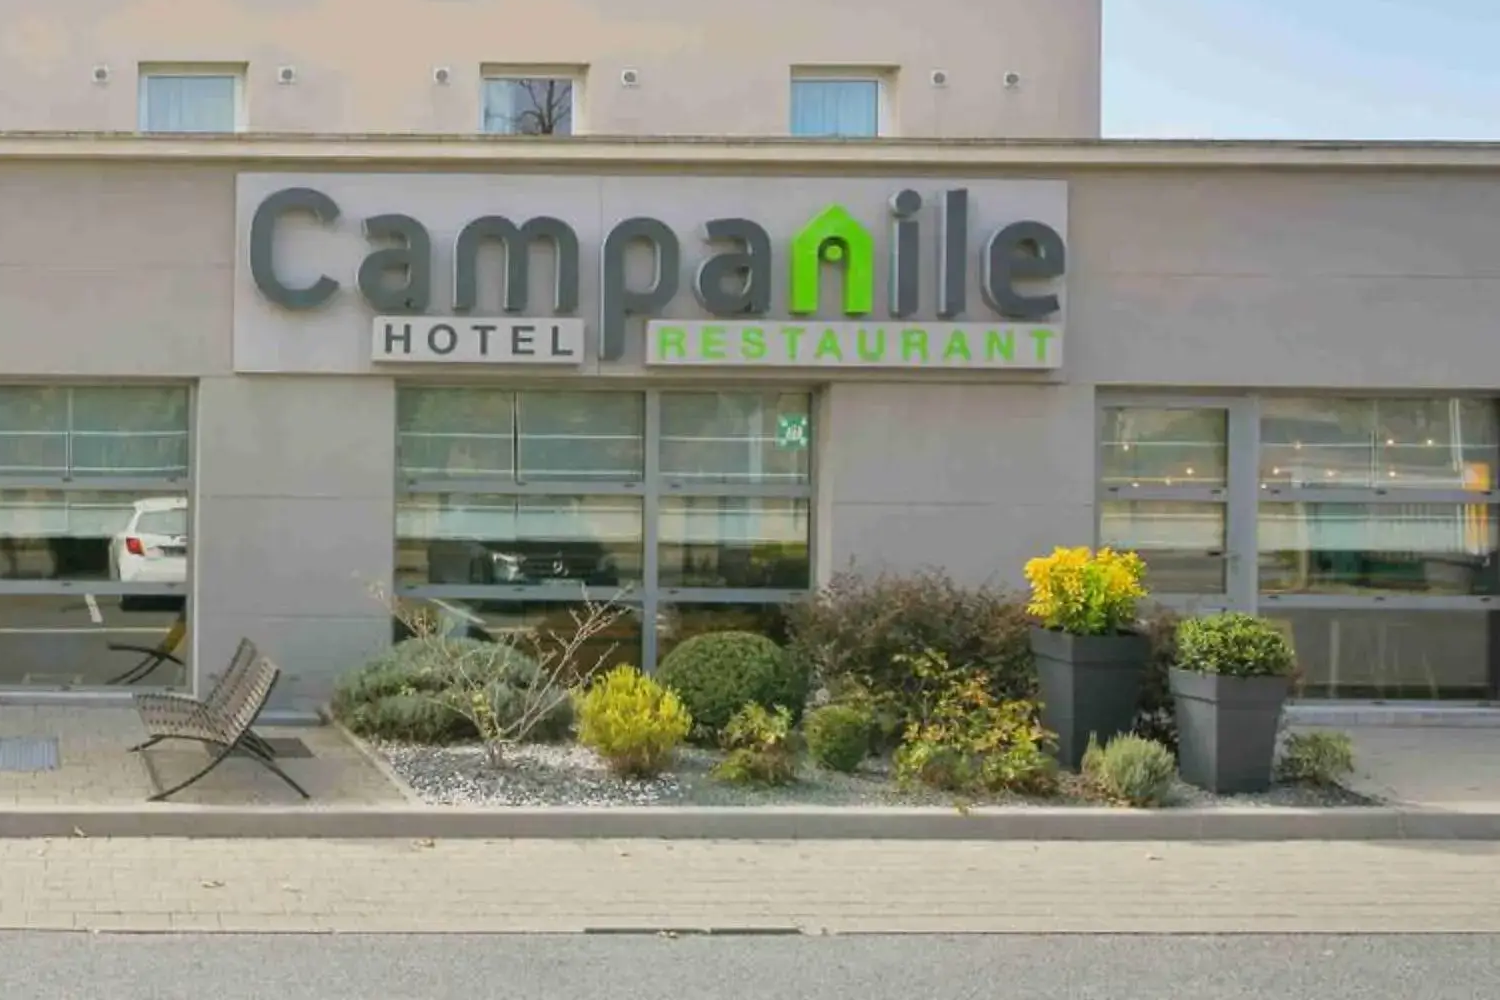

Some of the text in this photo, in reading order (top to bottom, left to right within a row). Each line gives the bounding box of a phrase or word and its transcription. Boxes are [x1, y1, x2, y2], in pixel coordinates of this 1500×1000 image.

[250, 187, 1066, 360] Campanile
[384, 325, 574, 356] HOTEL
[658, 327, 1056, 361] RESTAURANT
